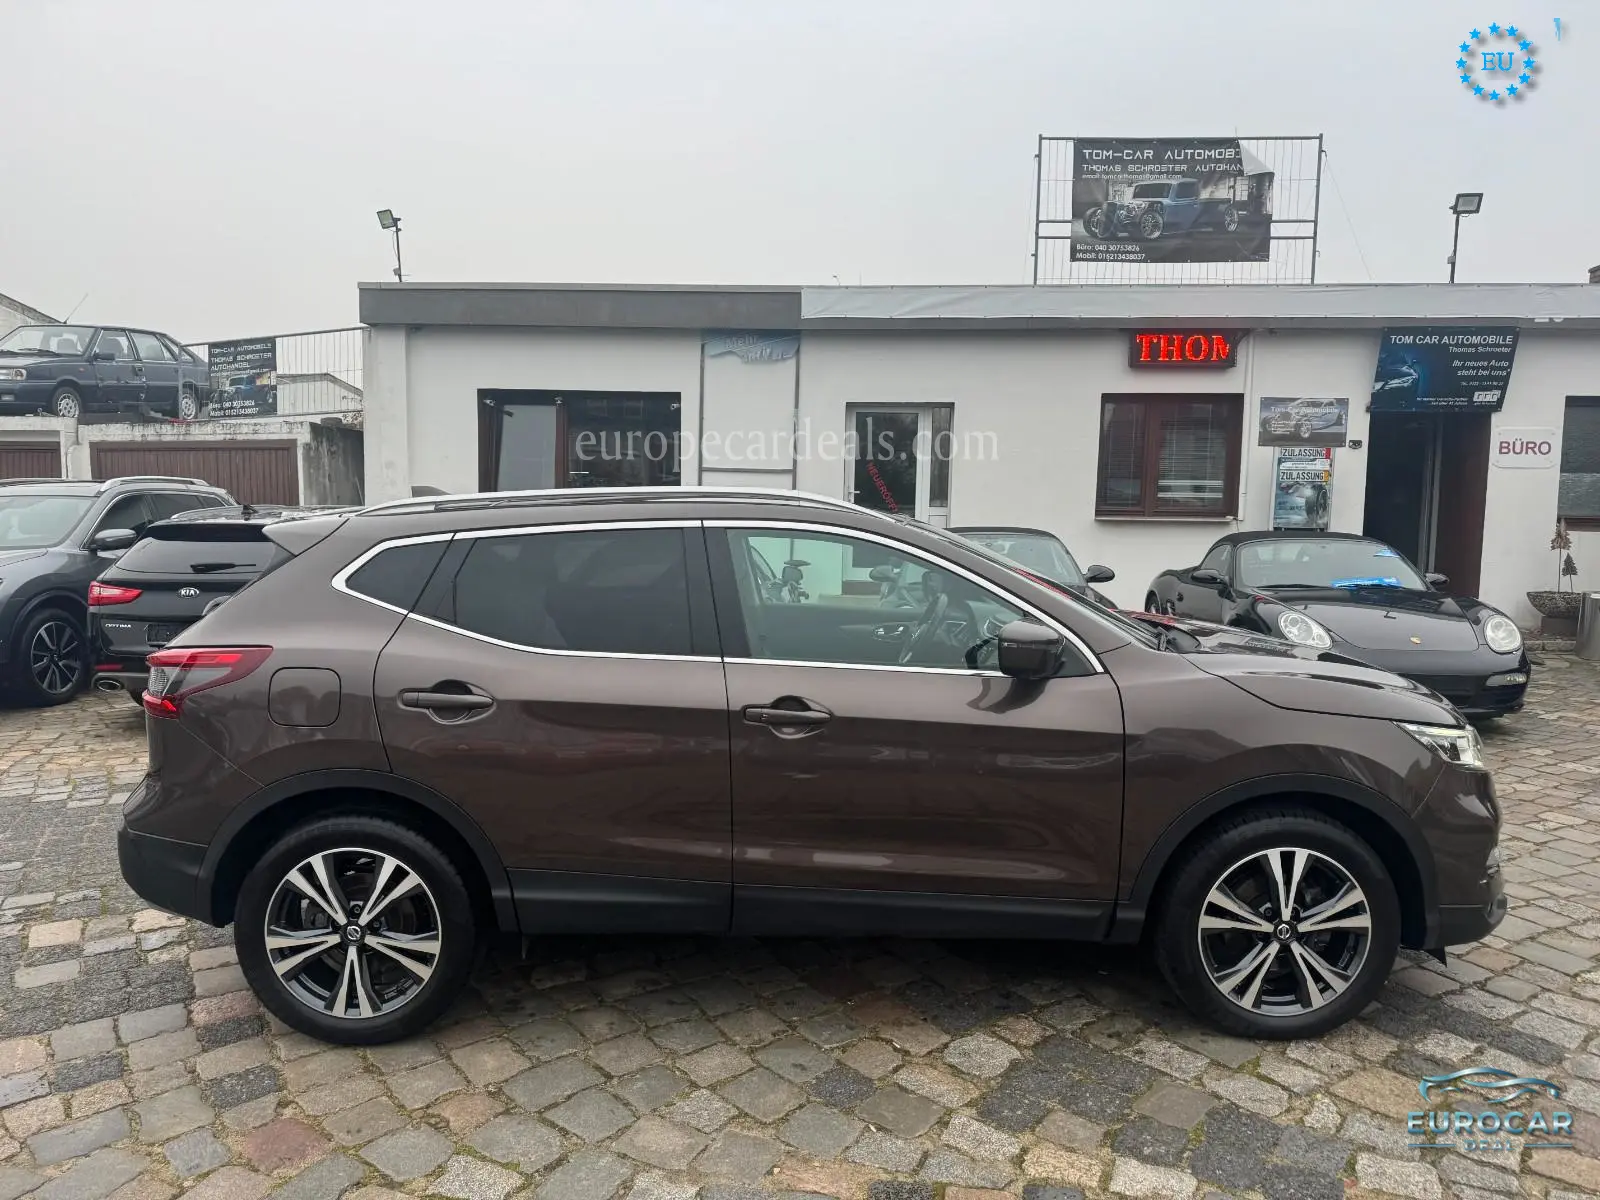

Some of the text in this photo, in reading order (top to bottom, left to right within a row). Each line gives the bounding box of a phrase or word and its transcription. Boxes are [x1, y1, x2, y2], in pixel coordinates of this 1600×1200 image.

[1083, 149, 1154, 160] TOM-CAR
[1082, 164, 1122, 172] THOMAS
[1128, 164, 1187, 172] SCHROETER
[1390, 335, 1514, 345] TOM CAR AUTOMOBILE
[211, 362, 251, 371] AUTOHANDEL
[1499, 438, 1552, 455] BÜRO
[1283, 448, 1325, 457] ZULASSUNG
[1281, 472, 1324, 481] ZULASSUNG
[180, 588, 197, 597] KIA
